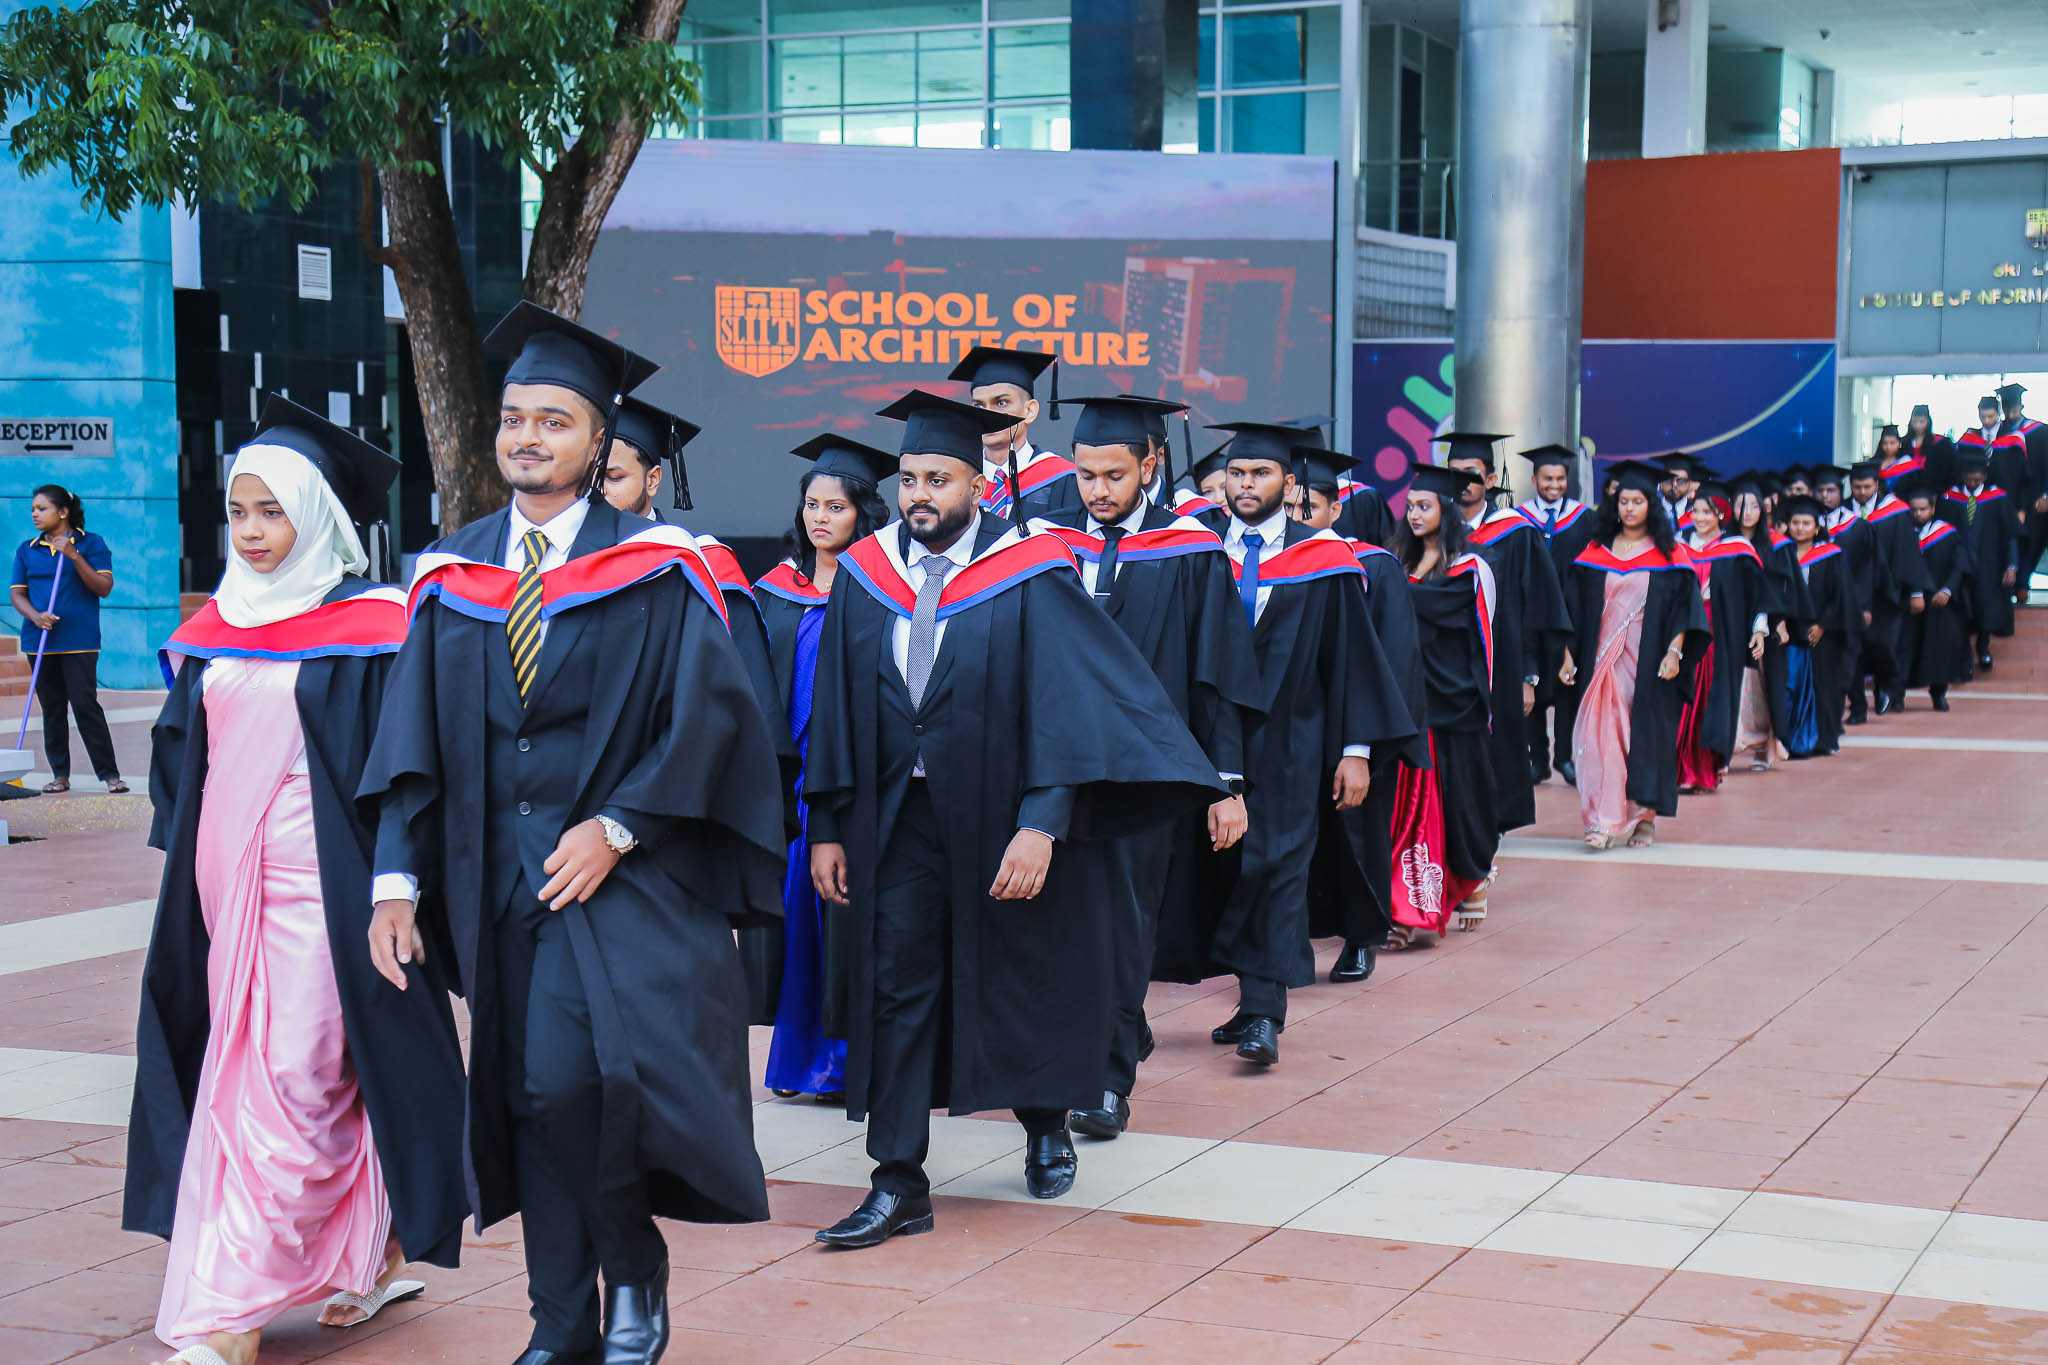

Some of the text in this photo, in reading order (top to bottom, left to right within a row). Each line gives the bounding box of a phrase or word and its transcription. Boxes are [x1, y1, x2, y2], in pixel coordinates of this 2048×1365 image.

[805, 290, 1077, 328] SCHOOL OF
[721, 314, 794, 346] SLIIT
[0, 423, 108, 441] ECEPTION
